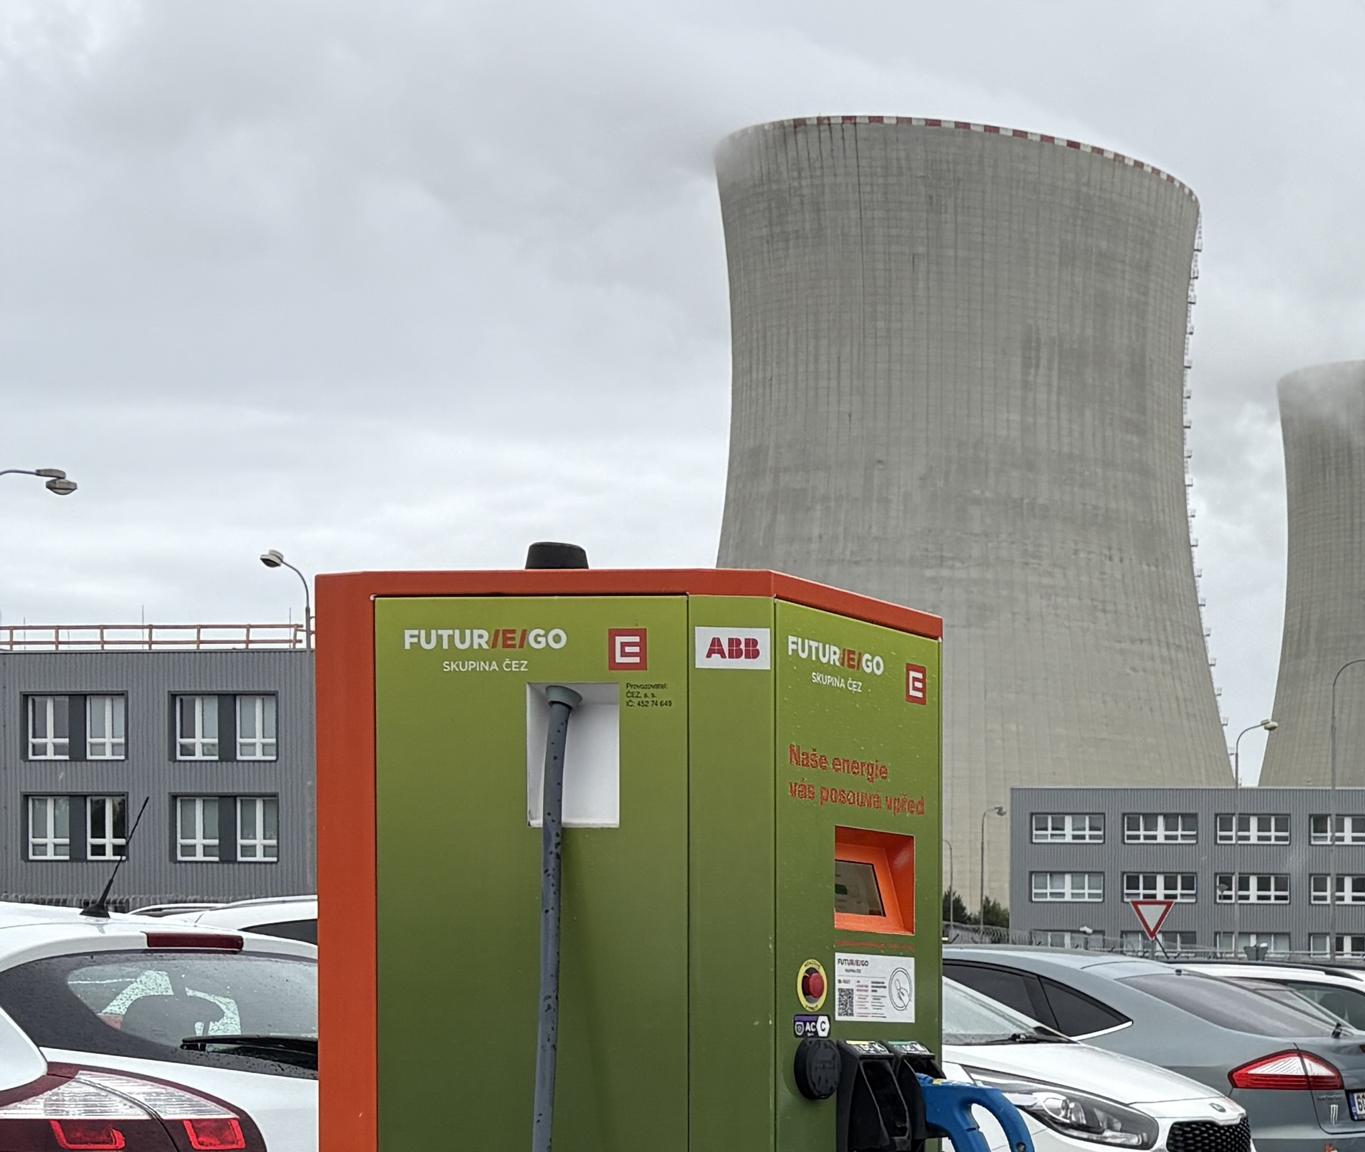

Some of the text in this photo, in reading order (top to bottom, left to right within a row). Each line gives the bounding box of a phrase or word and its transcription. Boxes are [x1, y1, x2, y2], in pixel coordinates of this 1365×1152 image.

[404, 628, 567, 650] FUTUR/E/GO
[705, 636, 760, 660] ABB
[443, 657, 528, 672] SKUPINA ČEZ
[787, 635, 884, 676] FUTUR/E/GO
[811, 671, 863, 693] SKUPINA ČEZ
[788, 742, 889, 784] Naše energie
[788, 776, 815, 801] vás
[885, 793, 925, 816] vpřed
[805, 1021, 816, 1032] AC
[820, 1021, 826, 1032] C
